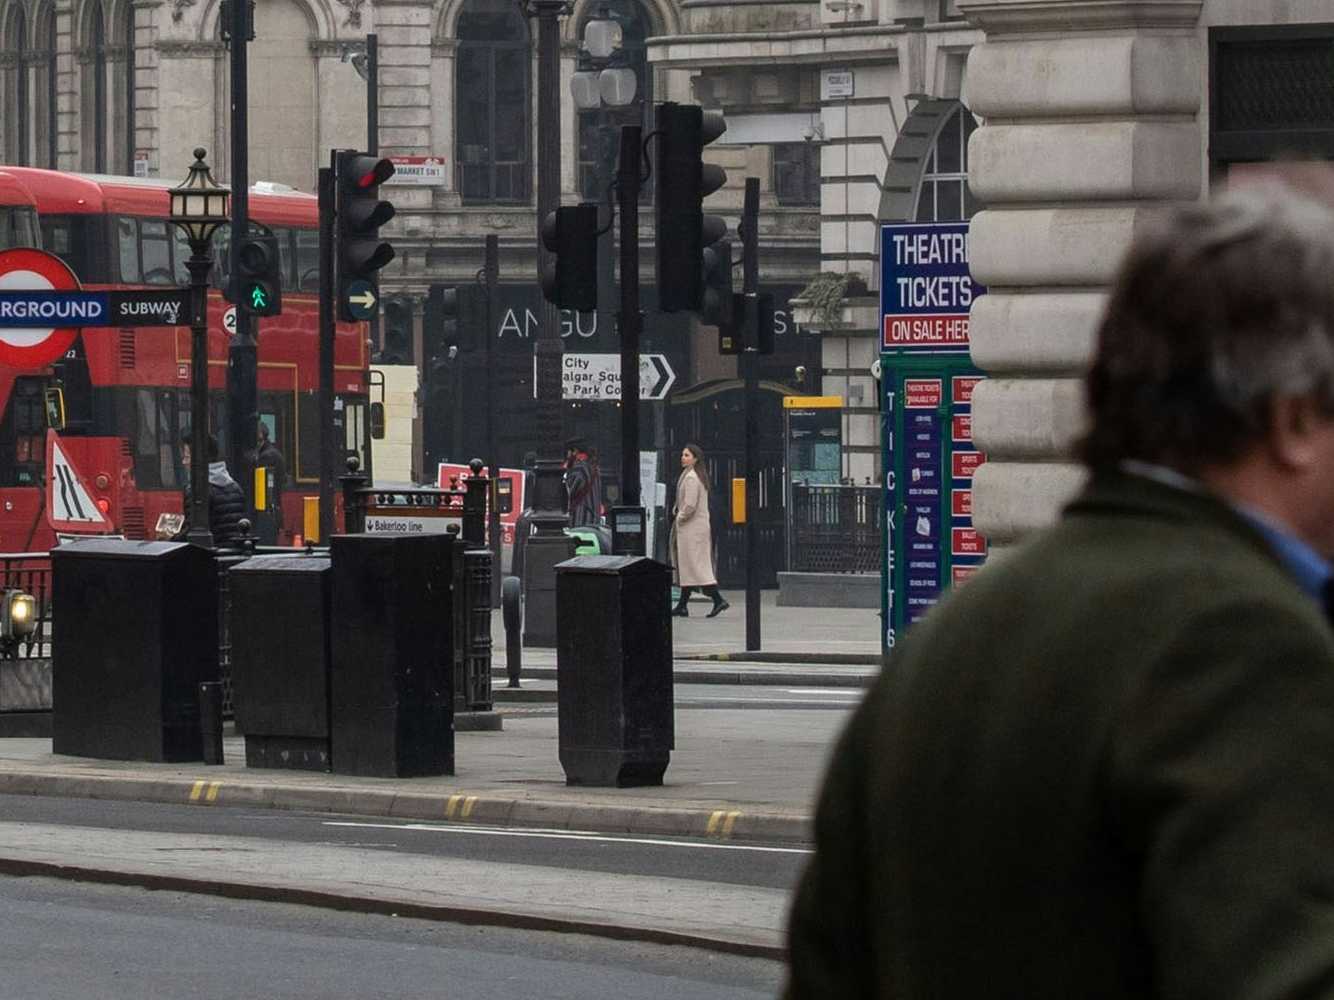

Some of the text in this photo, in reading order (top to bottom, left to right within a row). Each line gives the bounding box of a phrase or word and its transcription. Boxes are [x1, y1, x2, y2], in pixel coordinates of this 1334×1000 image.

[396, 167, 424, 176] MARKET
[897, 276, 972, 307] TICKETS
[120, 301, 181, 315] SUBWAY
[892, 319, 970, 340] ON SALE HER
[564, 358, 590, 371] City
[563, 371, 622, 386] algar Squ
[573, 384, 600, 395] Park
[374, 520, 423, 532] Bakerloo line
